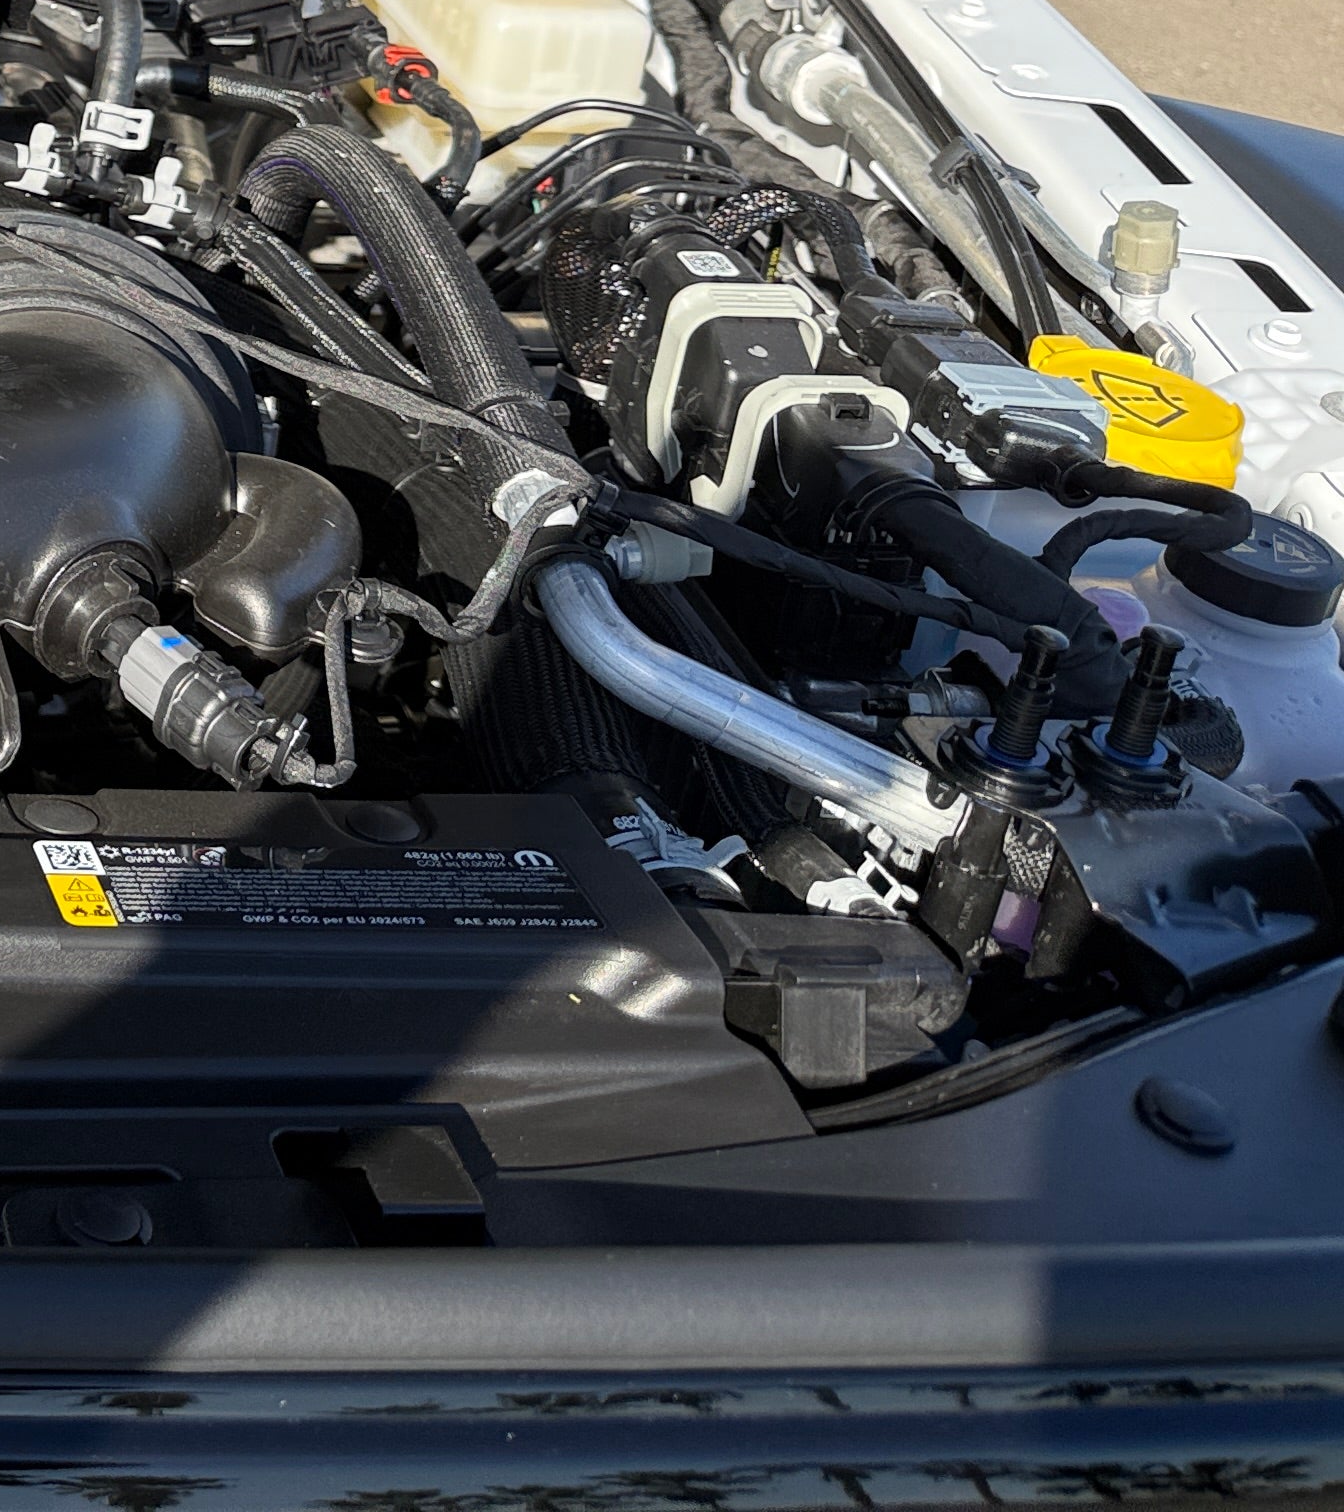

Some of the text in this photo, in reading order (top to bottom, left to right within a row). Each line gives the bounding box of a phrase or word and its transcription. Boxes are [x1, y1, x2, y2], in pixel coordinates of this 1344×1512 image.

[125, 855, 155, 864] GWP
[242, 914, 274, 924] GWP
[291, 915, 321, 925] CO2
[322, 917, 343, 926] per
[346, 916, 365, 925] EU
[454, 917, 484, 926] SAE
